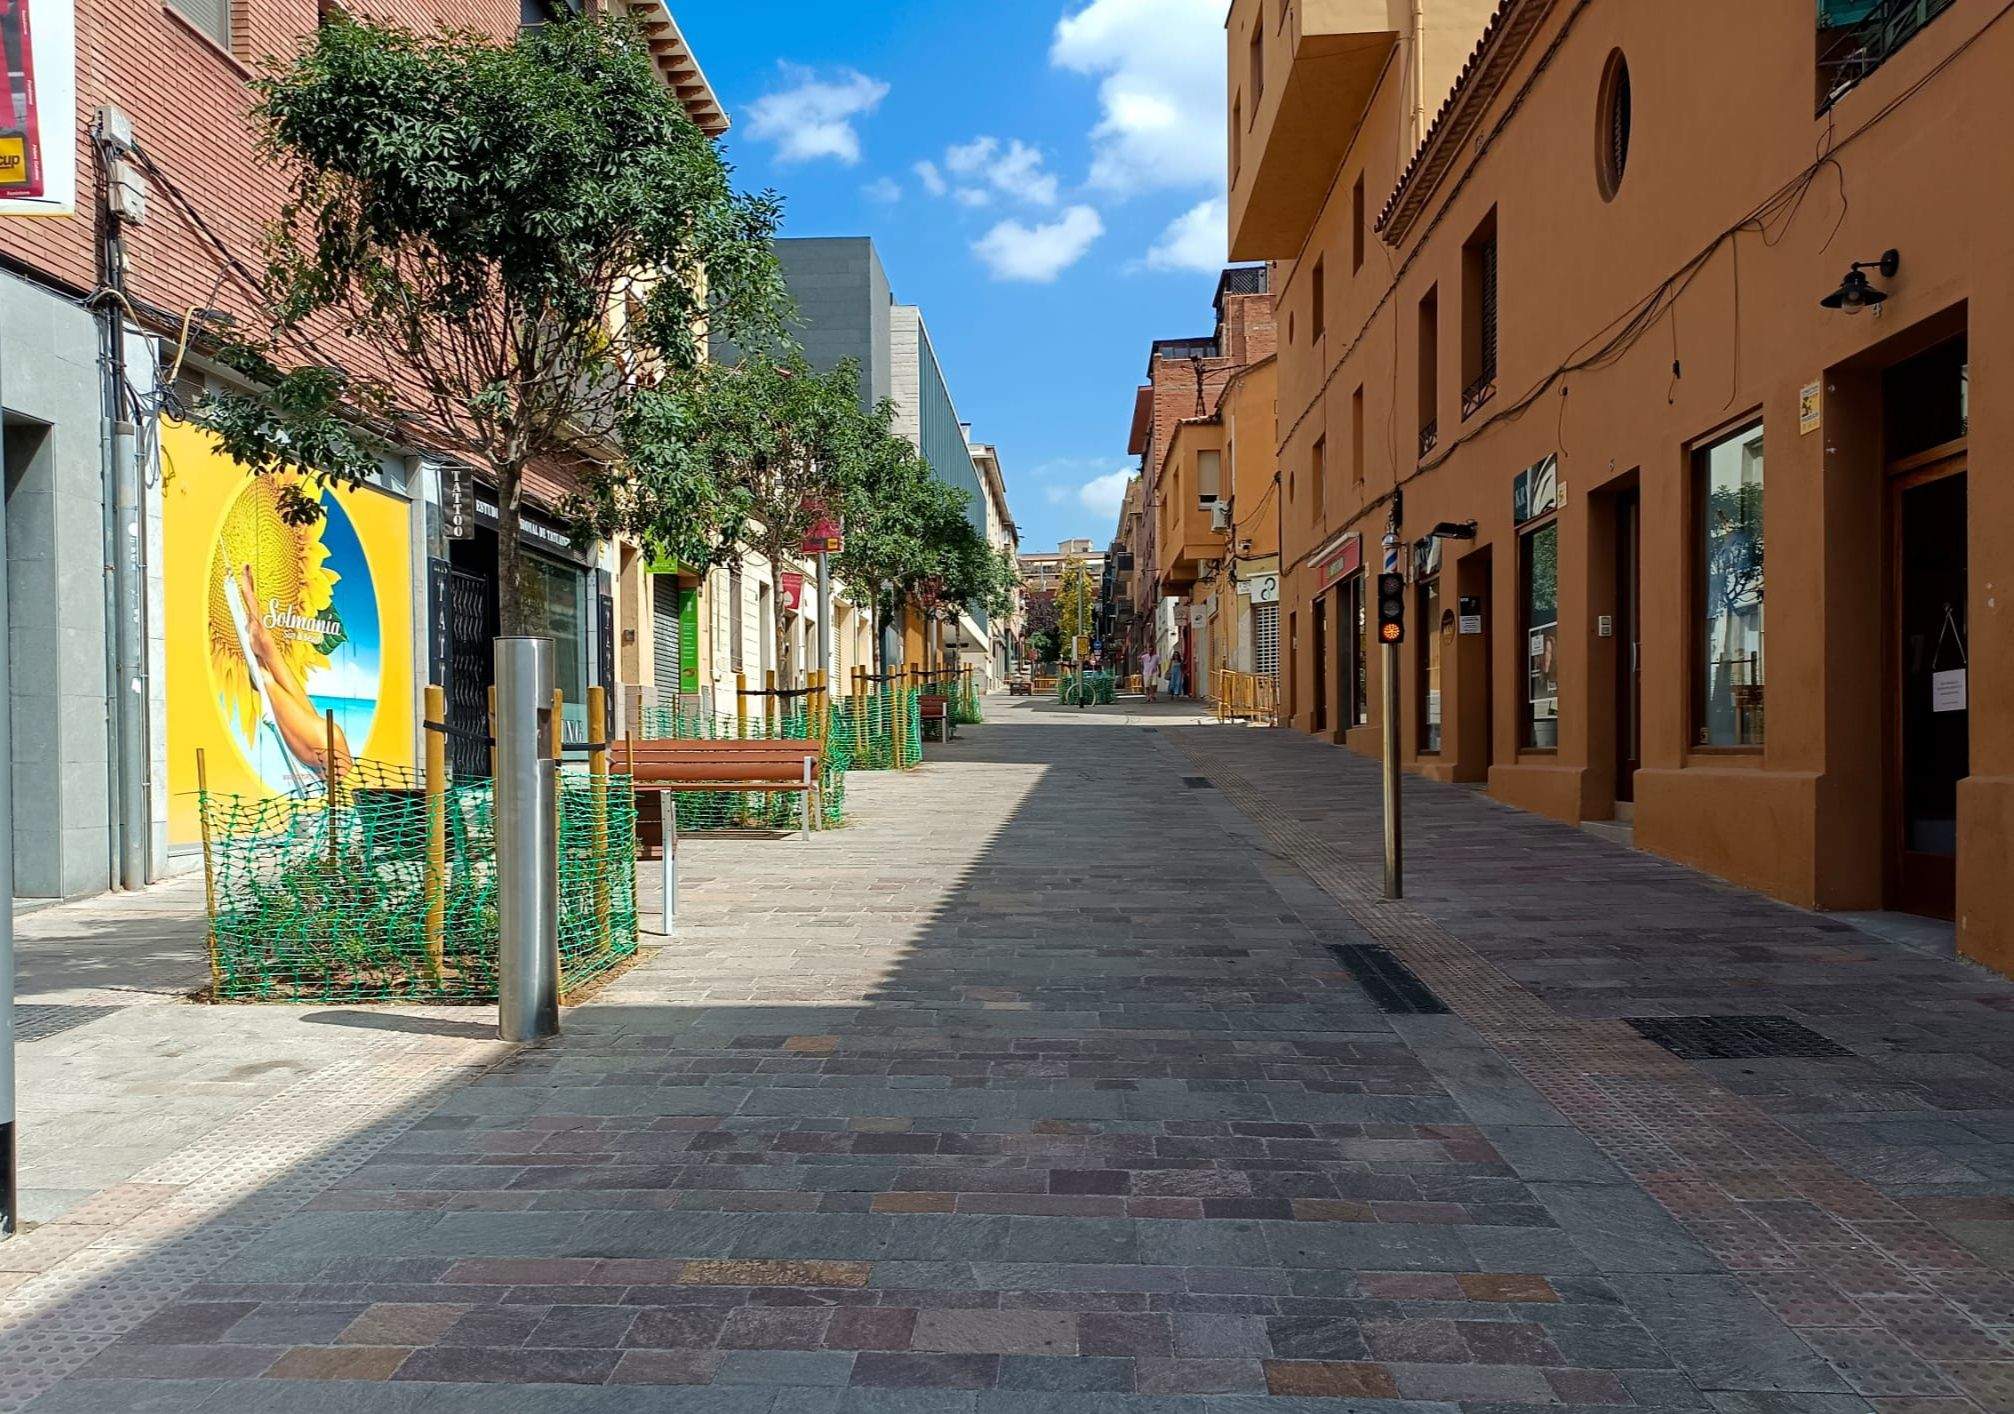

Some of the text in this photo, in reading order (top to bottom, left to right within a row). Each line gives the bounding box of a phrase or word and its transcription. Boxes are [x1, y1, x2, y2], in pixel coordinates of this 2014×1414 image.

[451, 471, 463, 537] TATTOO
[263, 598, 342, 636] Solmania
[439, 579, 448, 745] TATT
